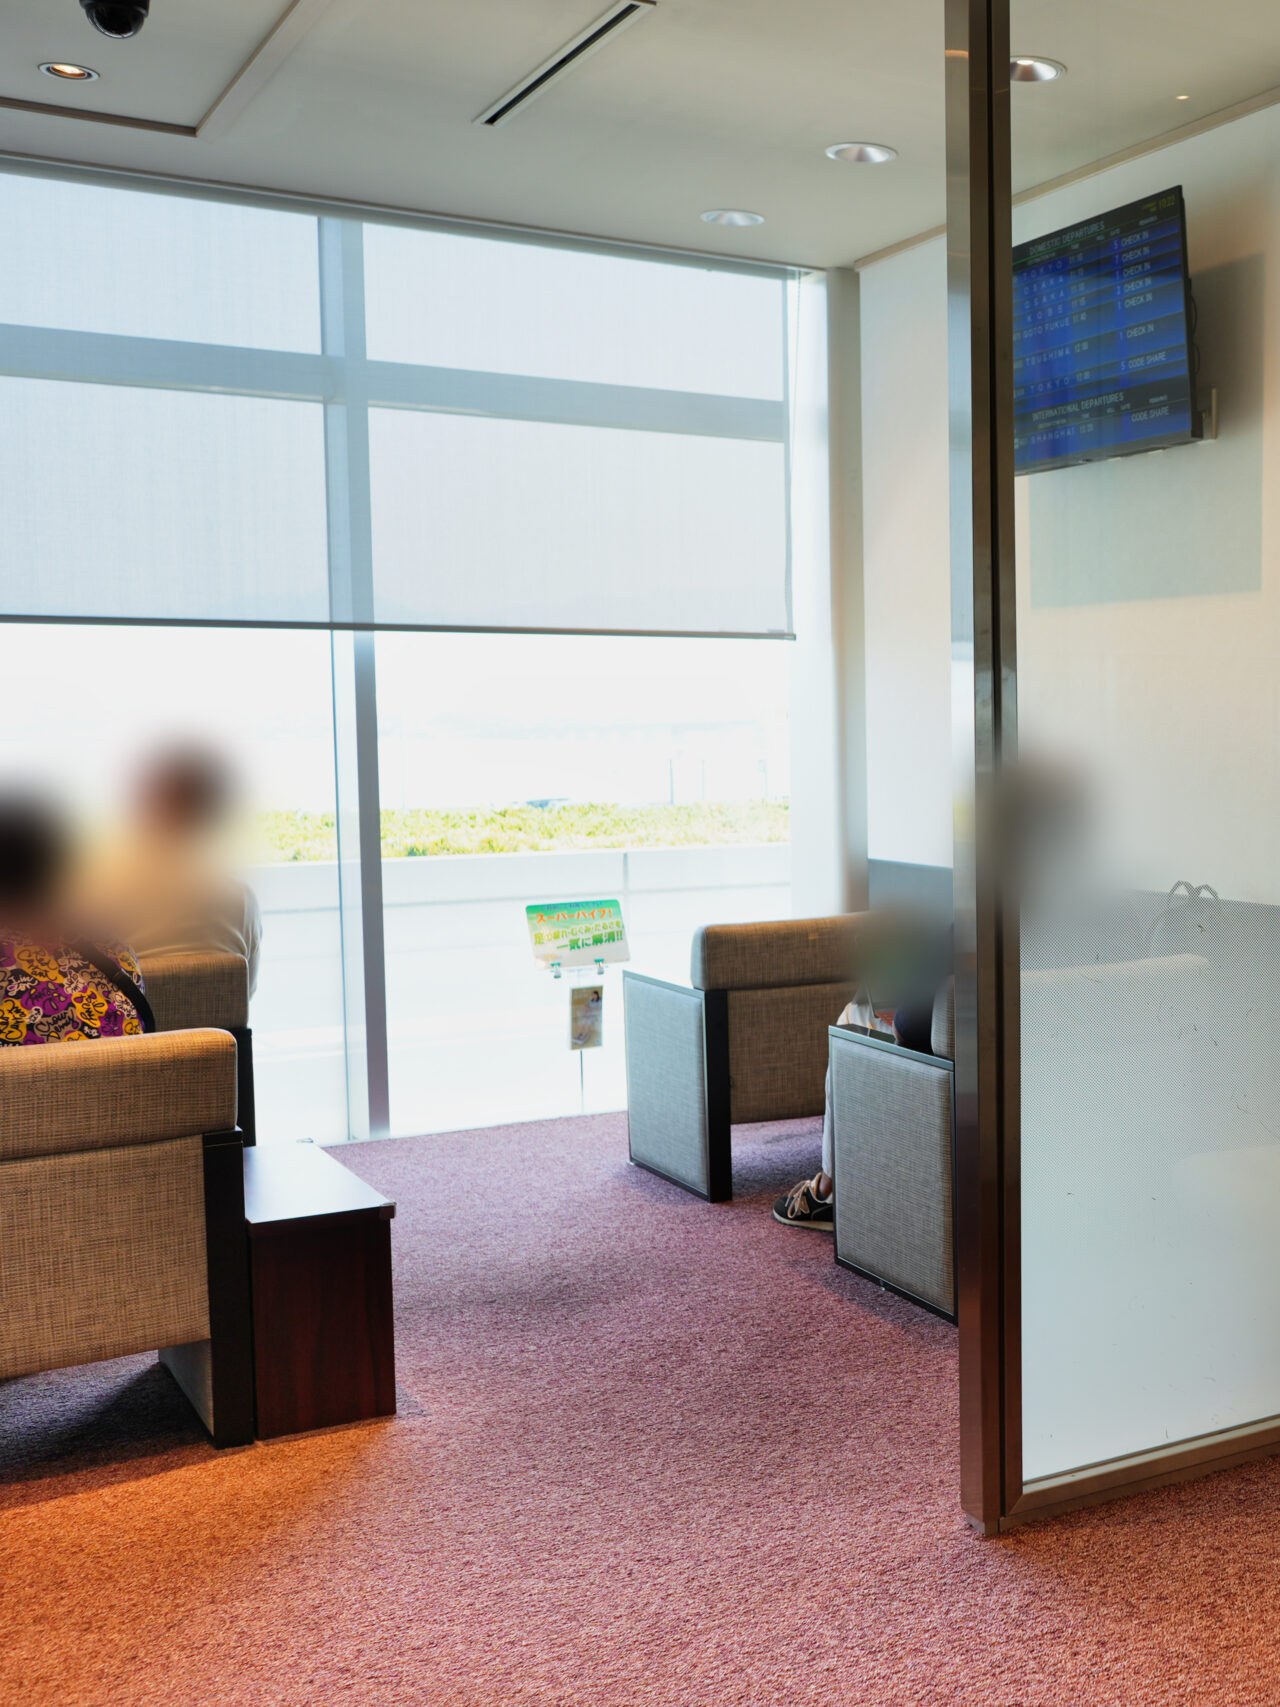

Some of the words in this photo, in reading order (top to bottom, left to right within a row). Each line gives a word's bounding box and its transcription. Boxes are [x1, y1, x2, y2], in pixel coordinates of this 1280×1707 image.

[1022, 260, 1063, 278] TOKYO
[1121, 233, 1141, 247] CHECK
[1142, 230, 1149, 242] IN
[1029, 237, 1061, 256] DOMESTIC
[1062, 221, 1104, 243] DEPARTURES
[1024, 275, 1064, 294] OSAKA
[1122, 249, 1141, 263] CHECK
[1142, 246, 1150, 256] IN
[1024, 289, 1065, 309] OSAKA
[1123, 264, 1143, 278] CHECK
[1143, 261, 1151, 271] IN
[1027, 304, 1063, 322] KOBE
[1124, 280, 1144, 293] CHECK
[1144, 277, 1152, 287] IN
[1045, 316, 1070, 331] FUKUE
[1125, 295, 1145, 309] CHECK
[1145, 292, 1153, 302] IN
[1025, 347, 1070, 367] TSUSHIMA
[1127, 325, 1146, 338] CHECK
[1147, 323, 1154, 333] IN
[1029, 376, 1070, 394] TOKYO
[1128, 356, 1145, 369] CODE
[1146, 351, 1167, 365] SHARE
[1030, 427, 1075, 445] SHANGHAI
[1131, 410, 1148, 423] CODE
[1149, 405, 1169, 419] SHARE
[1032, 403, 1080, 422] INTERNATIONAL
[1081, 392, 1124, 410] DEPARTURES
